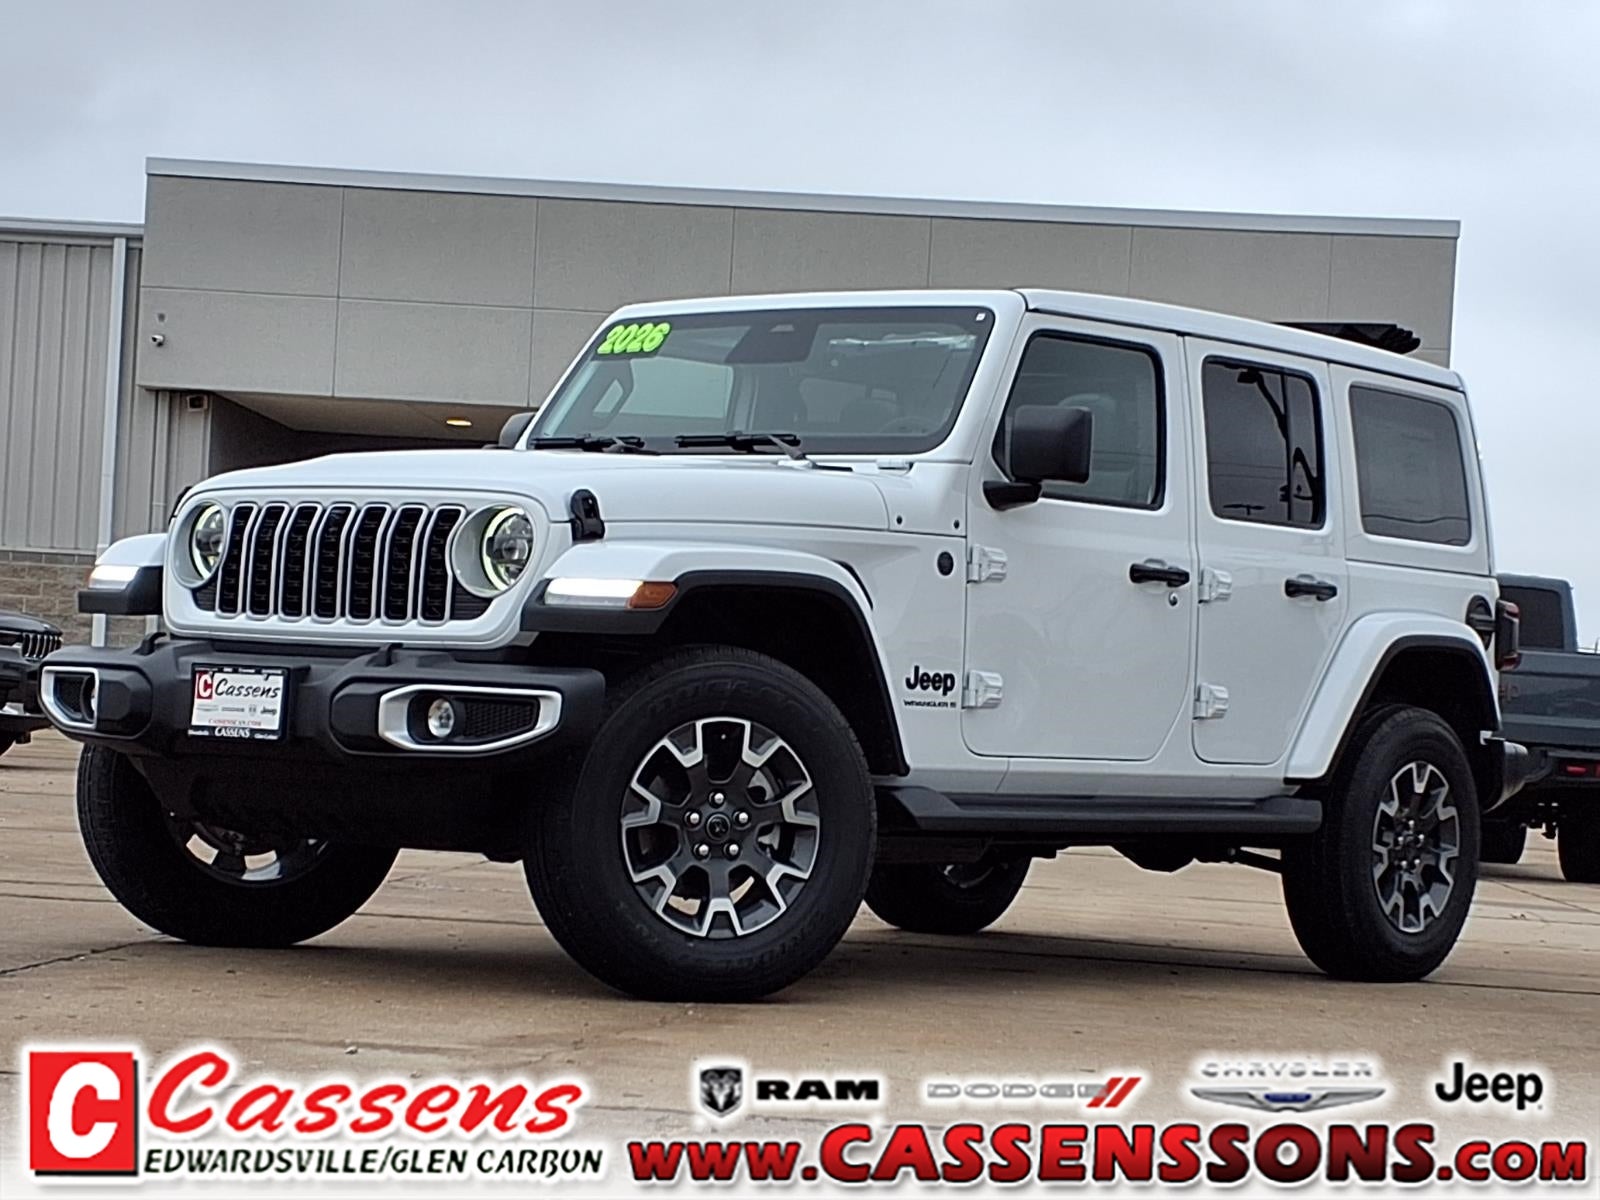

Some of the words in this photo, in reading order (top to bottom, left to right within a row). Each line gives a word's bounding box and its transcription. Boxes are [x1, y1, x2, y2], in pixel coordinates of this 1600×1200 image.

[597, 322, 671, 354] 2026
[215, 678, 280, 698] Cassens
[905, 665, 955, 696] Jeep
